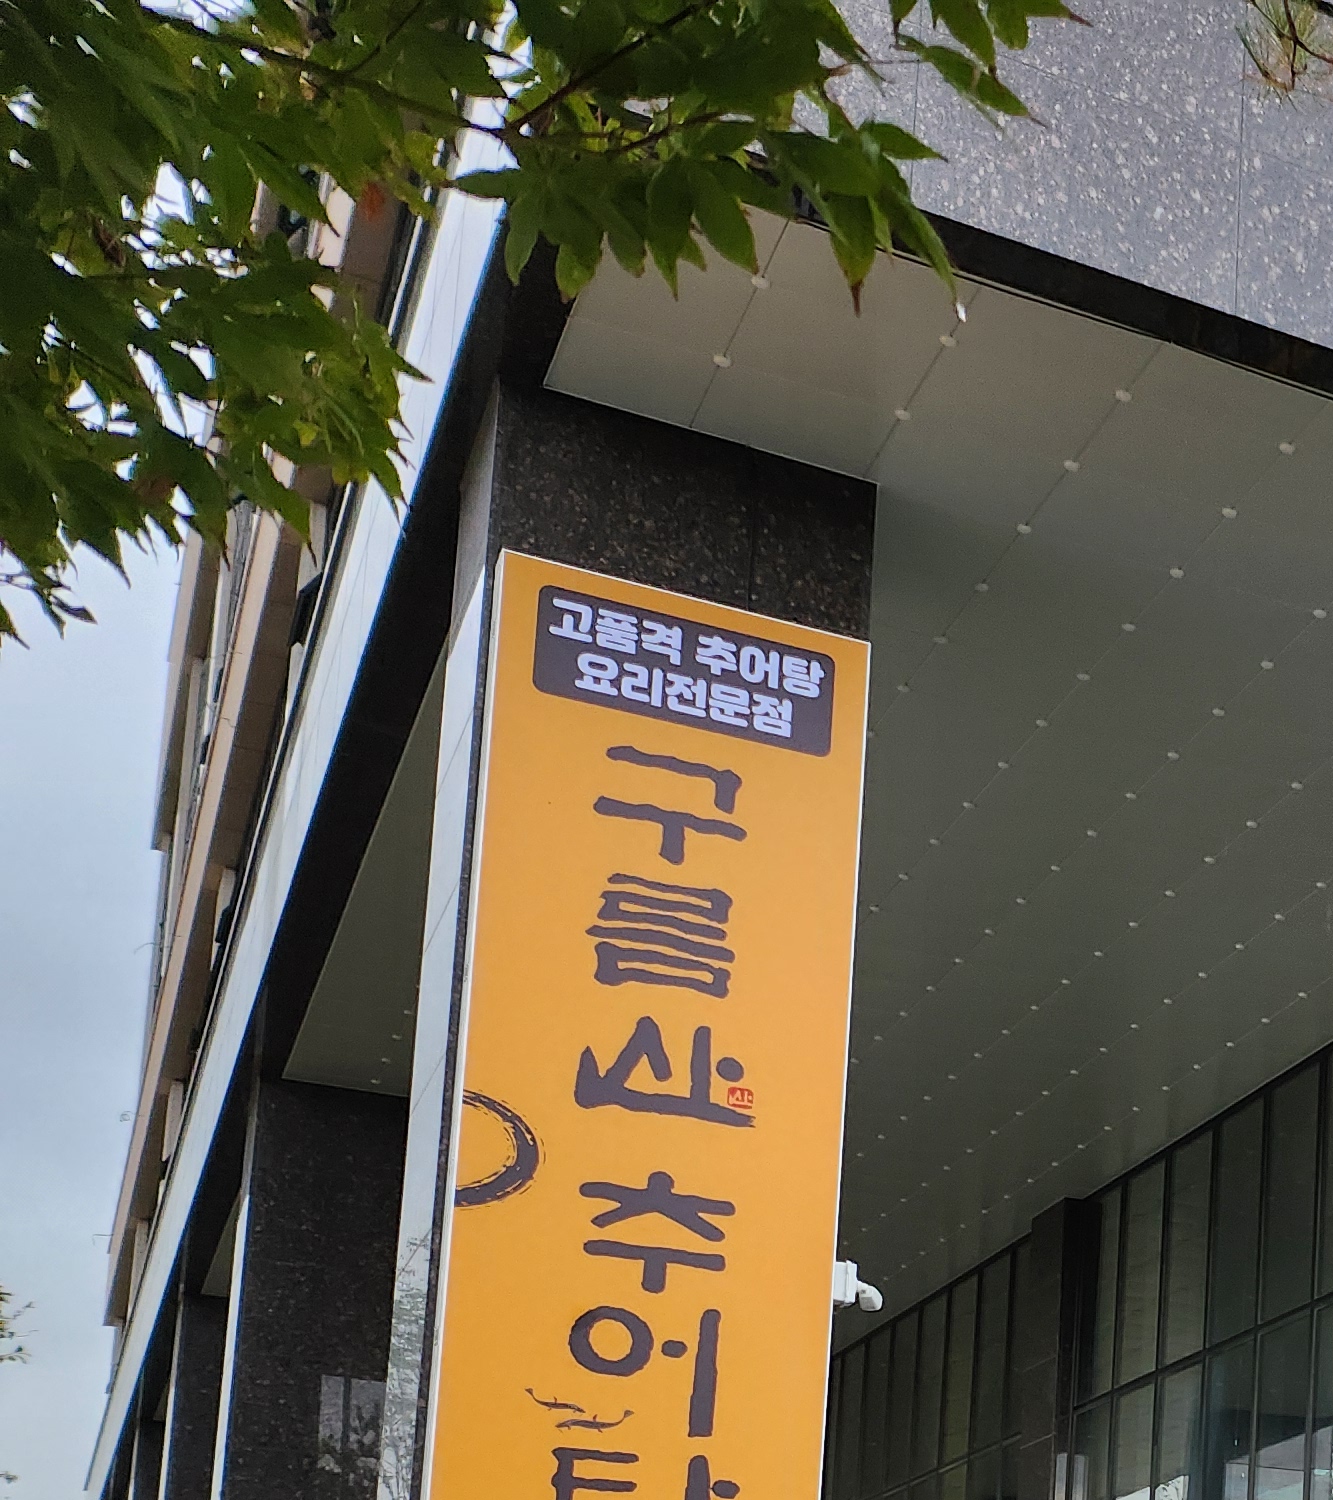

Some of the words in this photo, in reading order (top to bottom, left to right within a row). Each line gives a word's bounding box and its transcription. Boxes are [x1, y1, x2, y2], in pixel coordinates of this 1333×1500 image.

[549, 596, 683, 665] 고품격
[694, 633, 825, 700] 추어탕
[574, 652, 794, 738] 요리전문점
[574, 745, 756, 1127] 구름산
